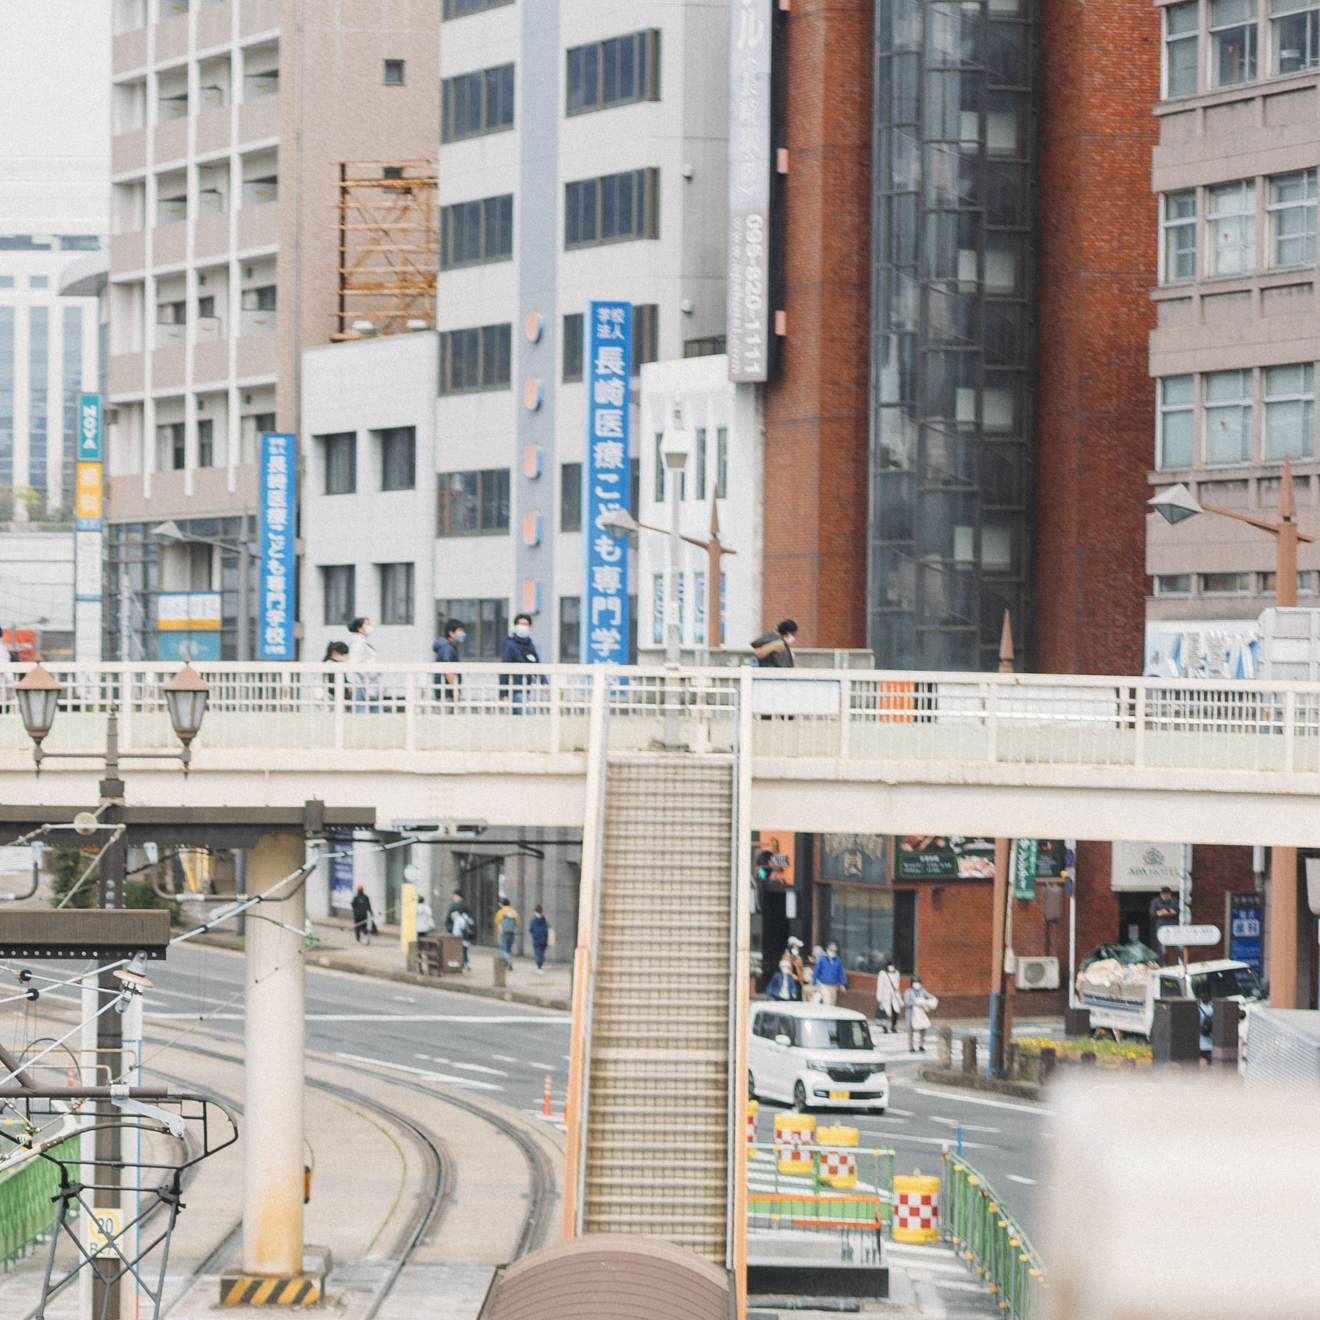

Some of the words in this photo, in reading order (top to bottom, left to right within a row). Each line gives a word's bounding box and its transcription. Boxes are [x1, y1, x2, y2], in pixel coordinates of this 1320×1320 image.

[82, 404, 98, 450] NOVA
[591, 346, 626, 664] 長崎医療こども専門学
